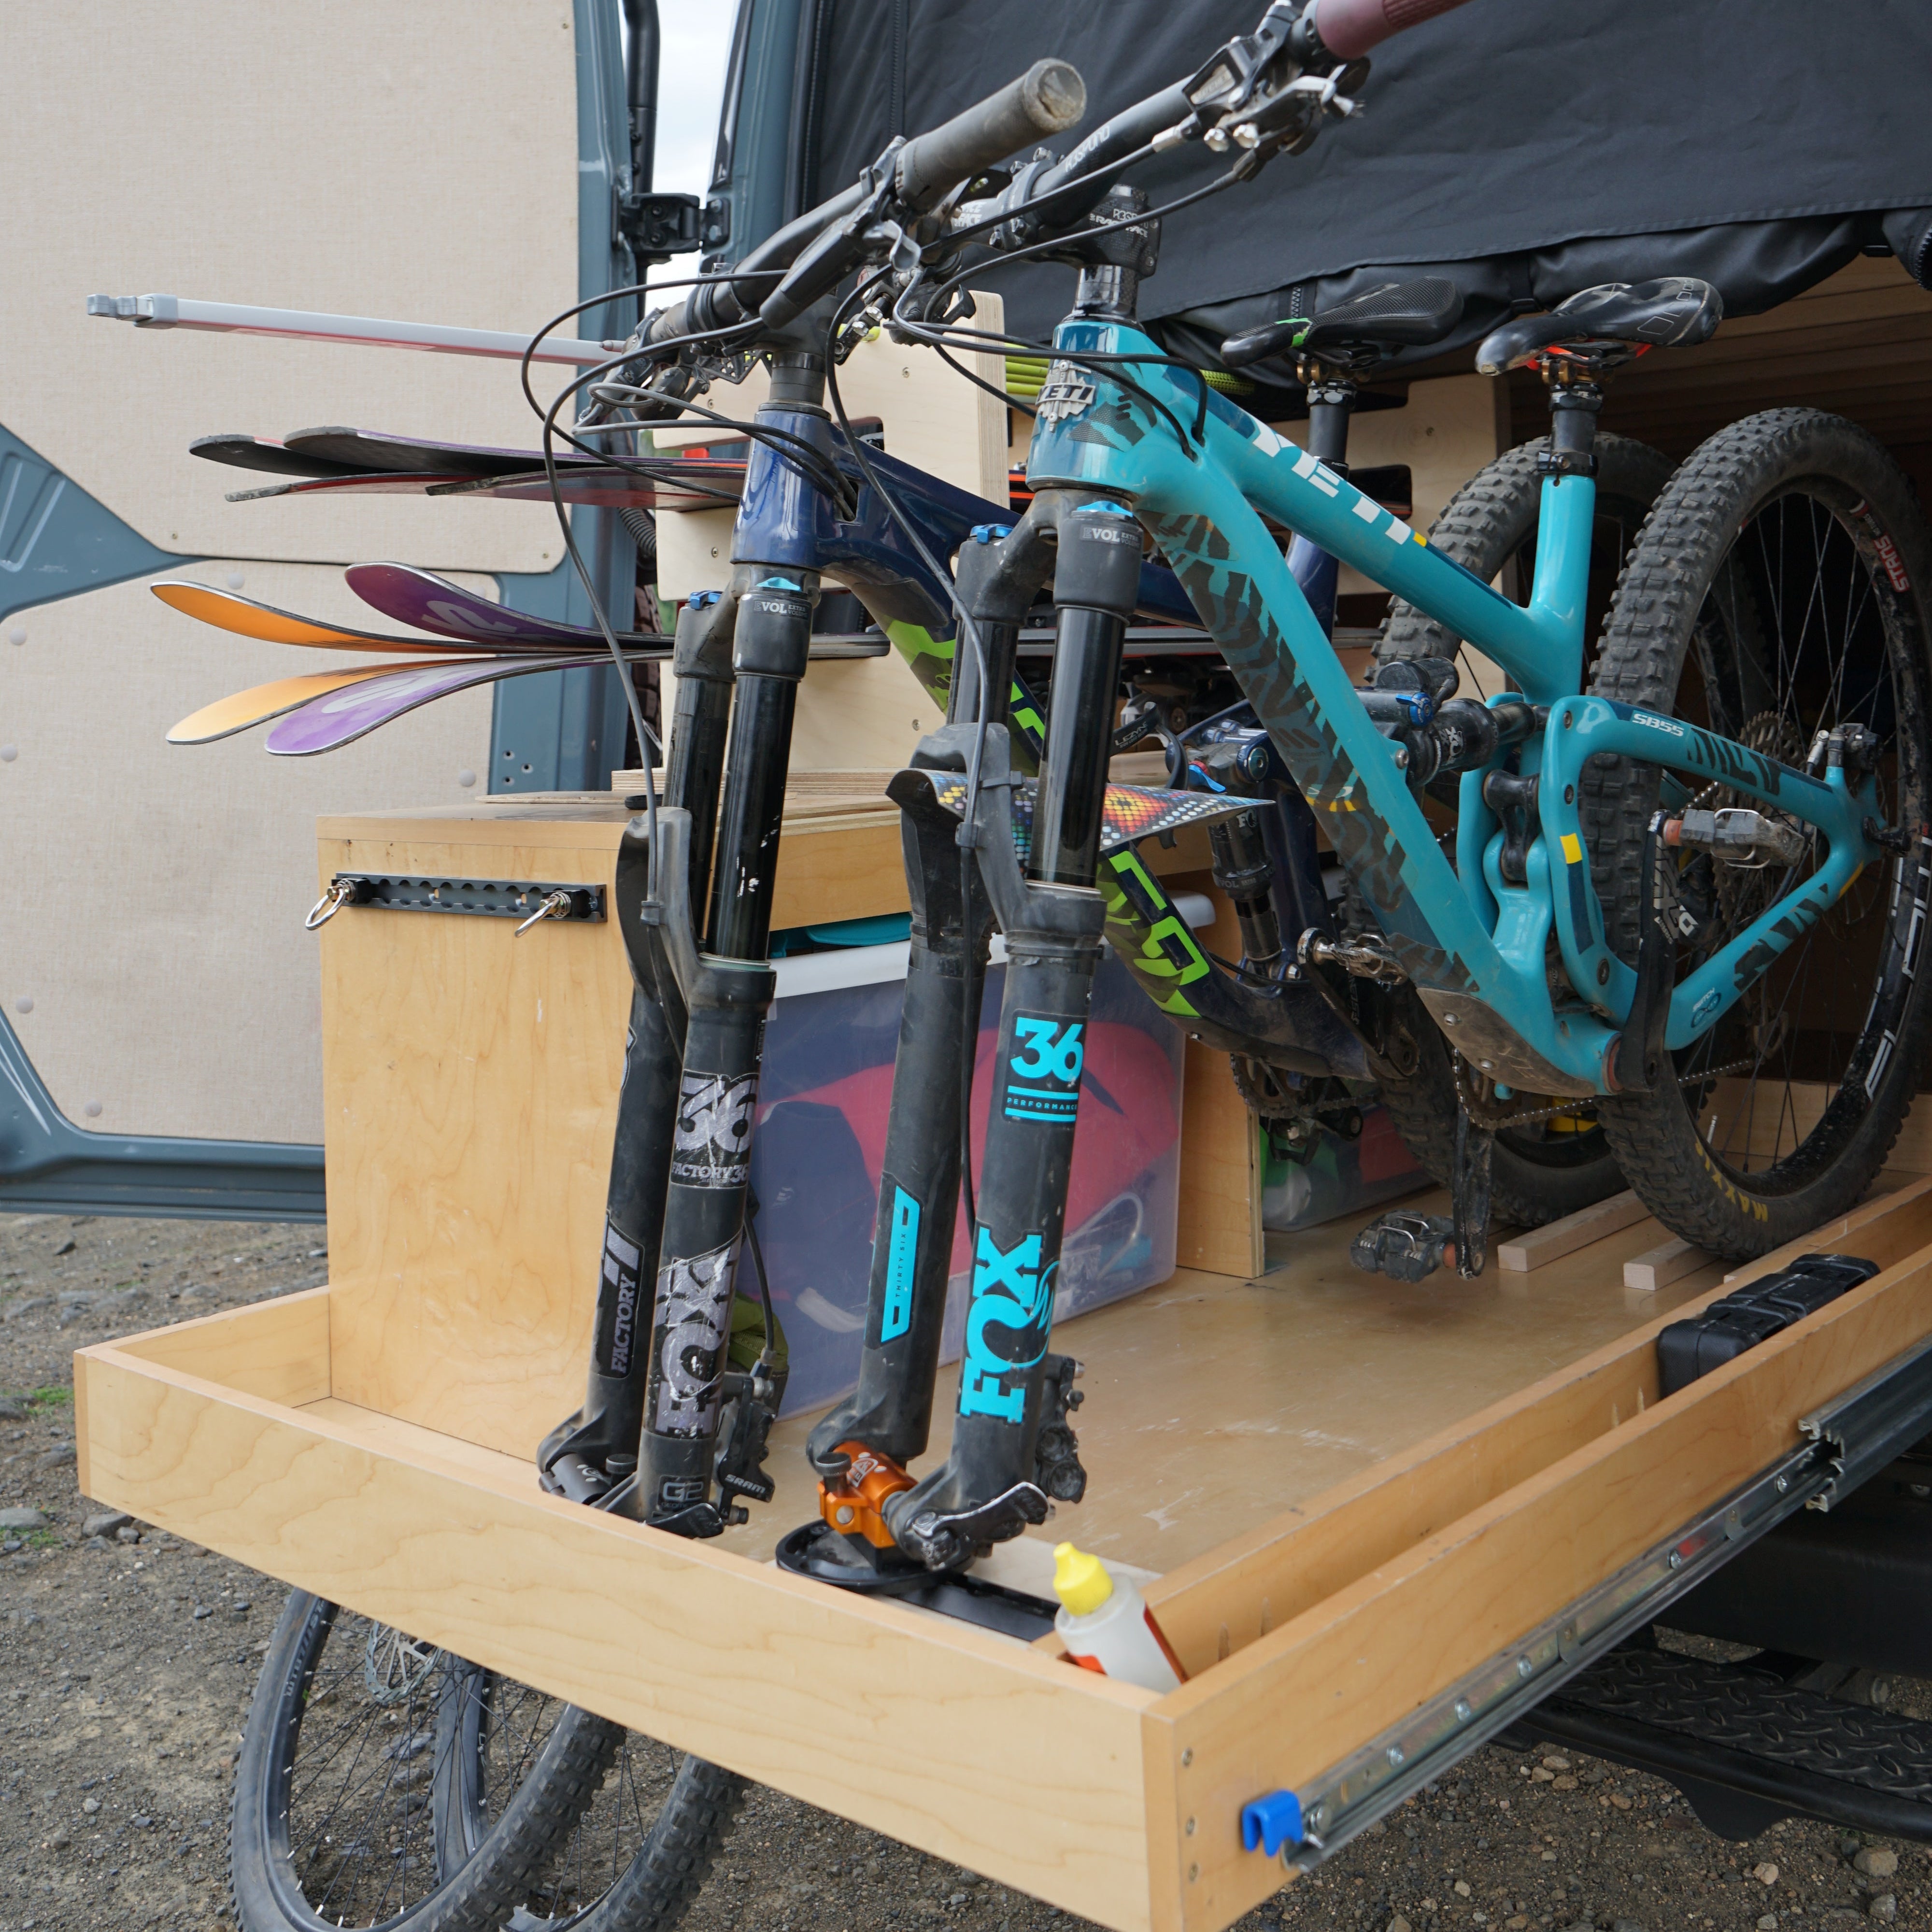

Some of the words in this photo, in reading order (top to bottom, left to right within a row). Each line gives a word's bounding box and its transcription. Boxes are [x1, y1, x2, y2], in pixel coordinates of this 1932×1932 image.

[1010, 1017, 1084, 1082] 36
[674, 1075, 758, 1153] 36
[671, 1161, 732, 1179] FACTORY
[895, 1257, 904, 1298] THIRTY
[611, 1273, 636, 1374] FACTORY
[655, 1236, 742, 1437] FOX
[960, 1226, 1058, 1424] FOX
[724, 1474, 766, 1494] SRAM
